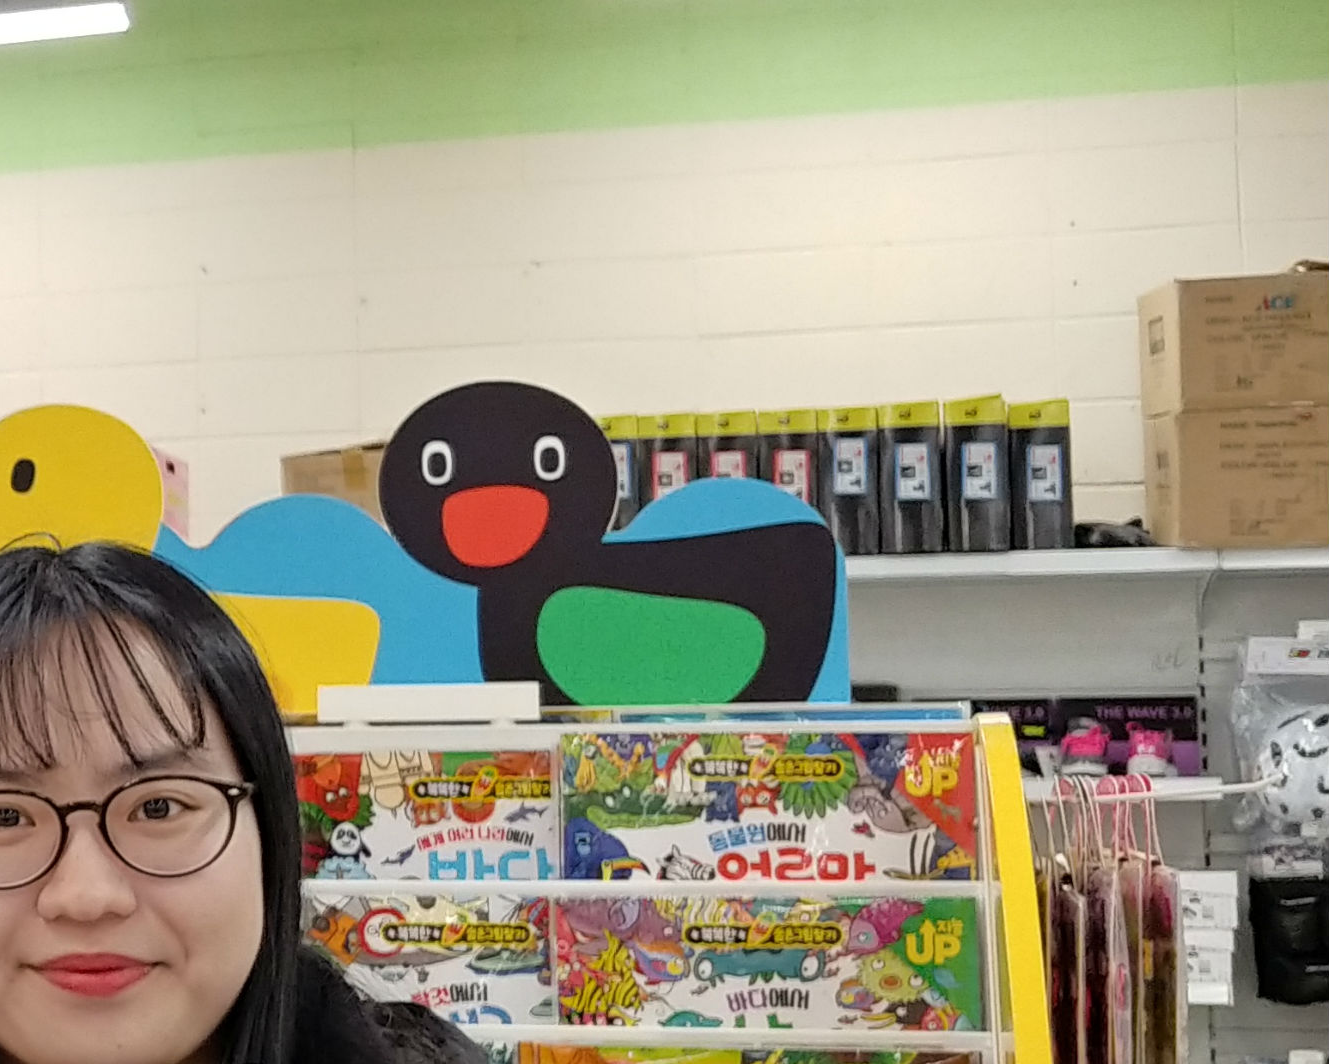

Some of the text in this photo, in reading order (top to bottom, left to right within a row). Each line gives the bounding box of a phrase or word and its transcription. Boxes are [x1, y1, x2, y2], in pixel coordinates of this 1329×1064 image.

[1127, 705, 1168, 719] WAVE
[905, 918, 961, 966] UP
[726, 989, 810, 1012] 바다에서
